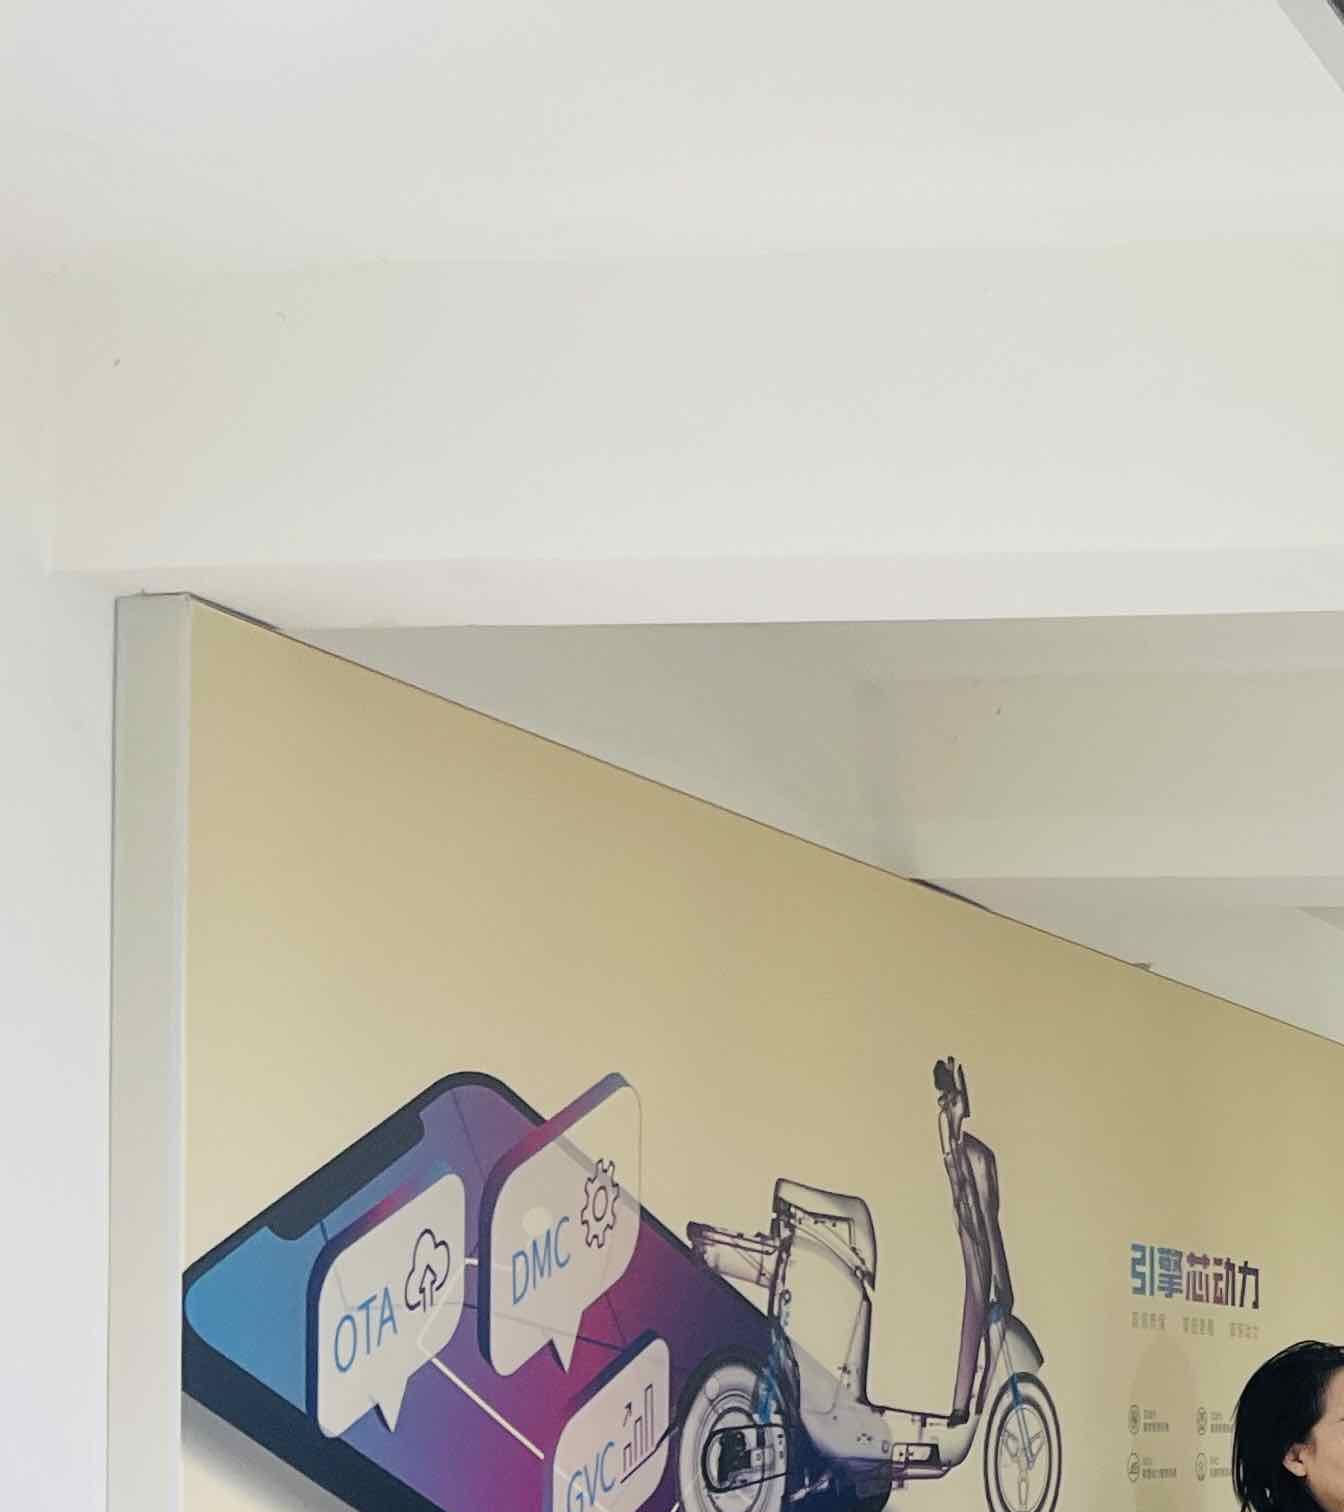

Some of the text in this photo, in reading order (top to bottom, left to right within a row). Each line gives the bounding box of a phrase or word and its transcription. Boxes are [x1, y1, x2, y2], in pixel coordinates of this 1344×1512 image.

[512, 1216, 571, 1305] DMC
[1131, 1244, 1259, 1309] 引擎芯动力
[334, 1287, 398, 1373] OTA
